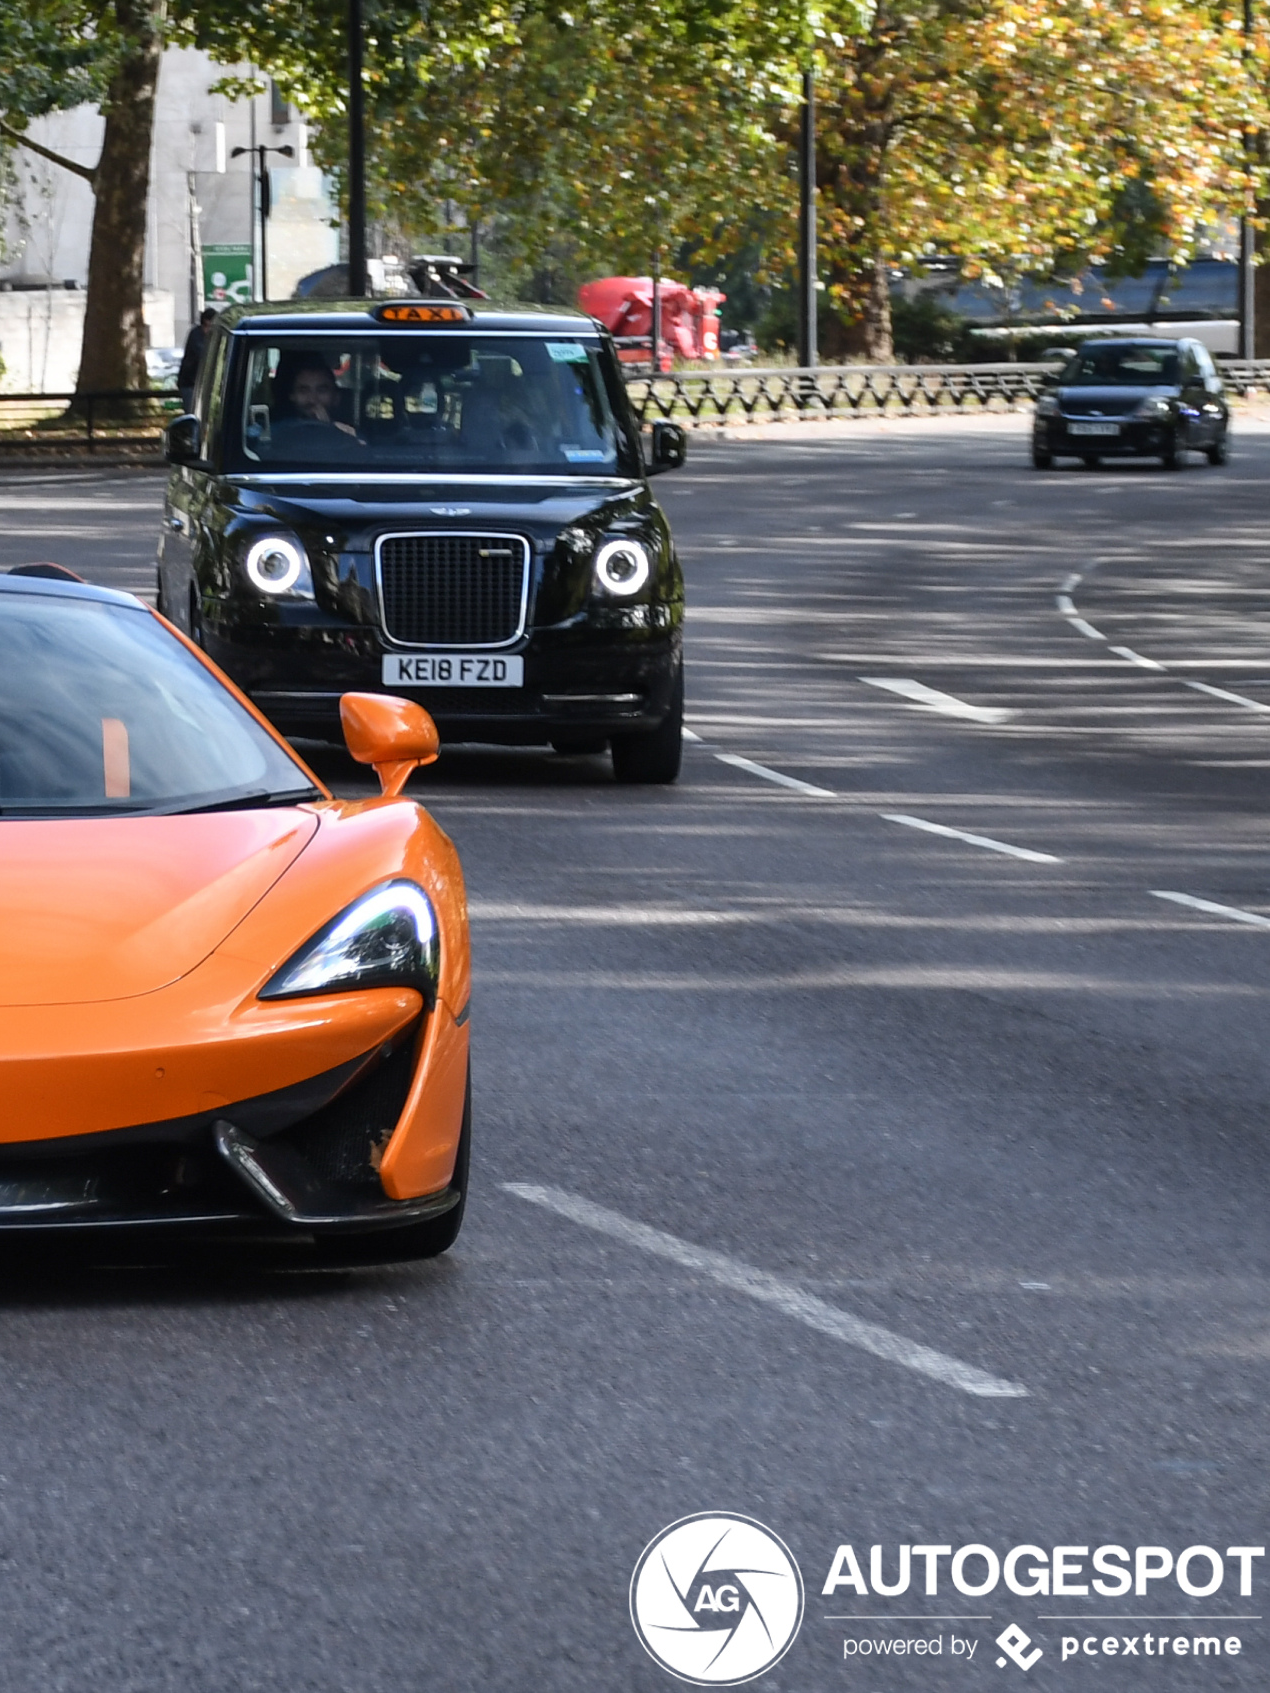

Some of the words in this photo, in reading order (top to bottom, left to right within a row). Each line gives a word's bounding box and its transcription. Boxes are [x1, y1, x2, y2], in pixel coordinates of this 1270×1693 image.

[390, 307, 457, 321] TAXI
[398, 658, 452, 681] KE18
[459, 659, 507, 681] FZD
